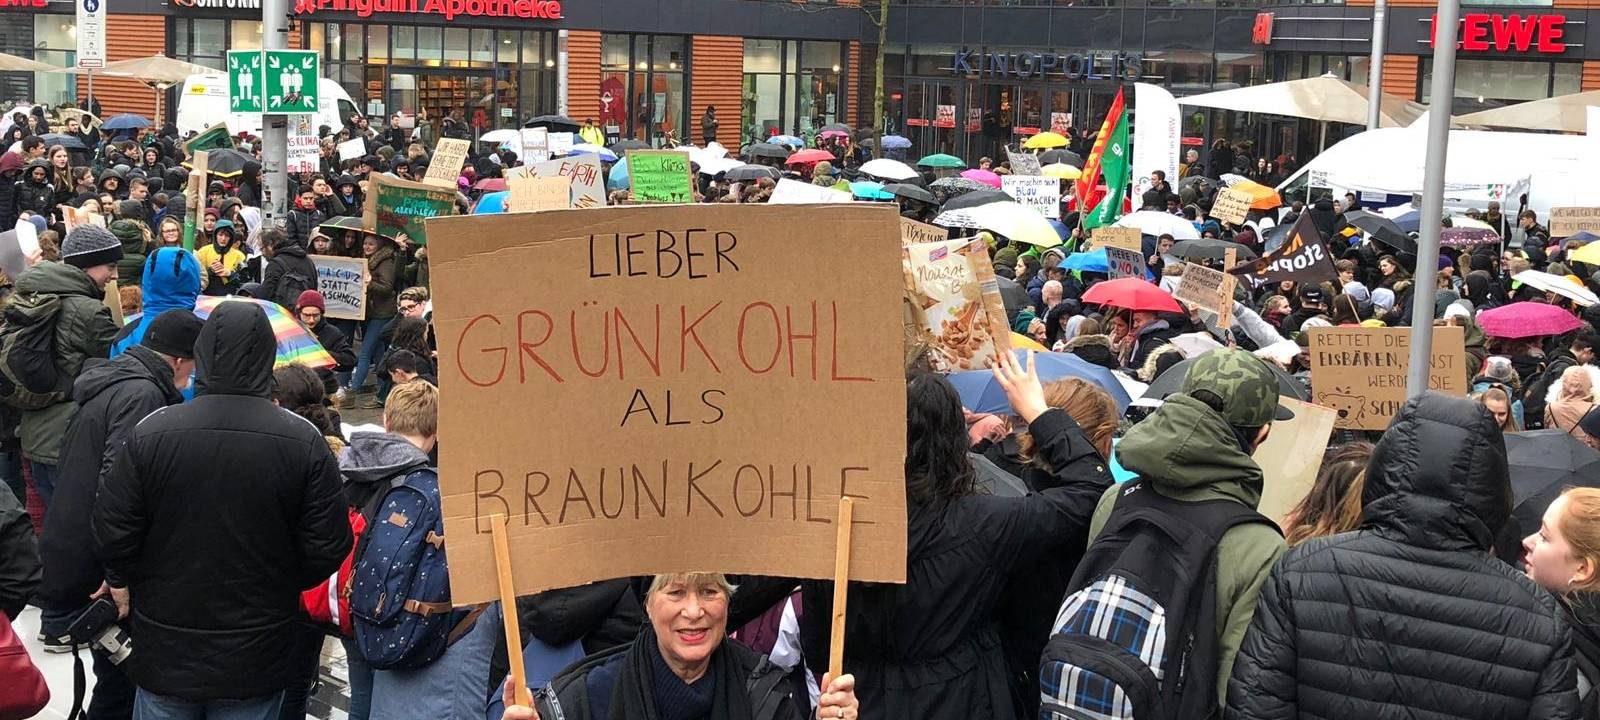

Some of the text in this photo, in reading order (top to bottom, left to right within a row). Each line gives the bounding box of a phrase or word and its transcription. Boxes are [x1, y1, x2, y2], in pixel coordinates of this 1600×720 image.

[424, 0, 562, 20] Apotheke
[1430, 13, 1566, 53] EWE
[954, 49, 1143, 82] KINOPOLIS
[296, 136, 319, 146] KLIMA
[558, 161, 598, 187] EARTH
[1027, 197, 1057, 205] MACHEN
[588, 229, 740, 280] LIEBER
[1117, 262, 1132, 275] NO
[321, 279, 349, 291] STATT
[456, 300, 876, 388] GRÜNKOHL
[1317, 333, 1408, 348] RETTET DIE
[1430, 374, 1453, 391] SIE
[620, 388, 726, 427] ALS
[473, 459, 876, 535] BRAUNKOHLE
